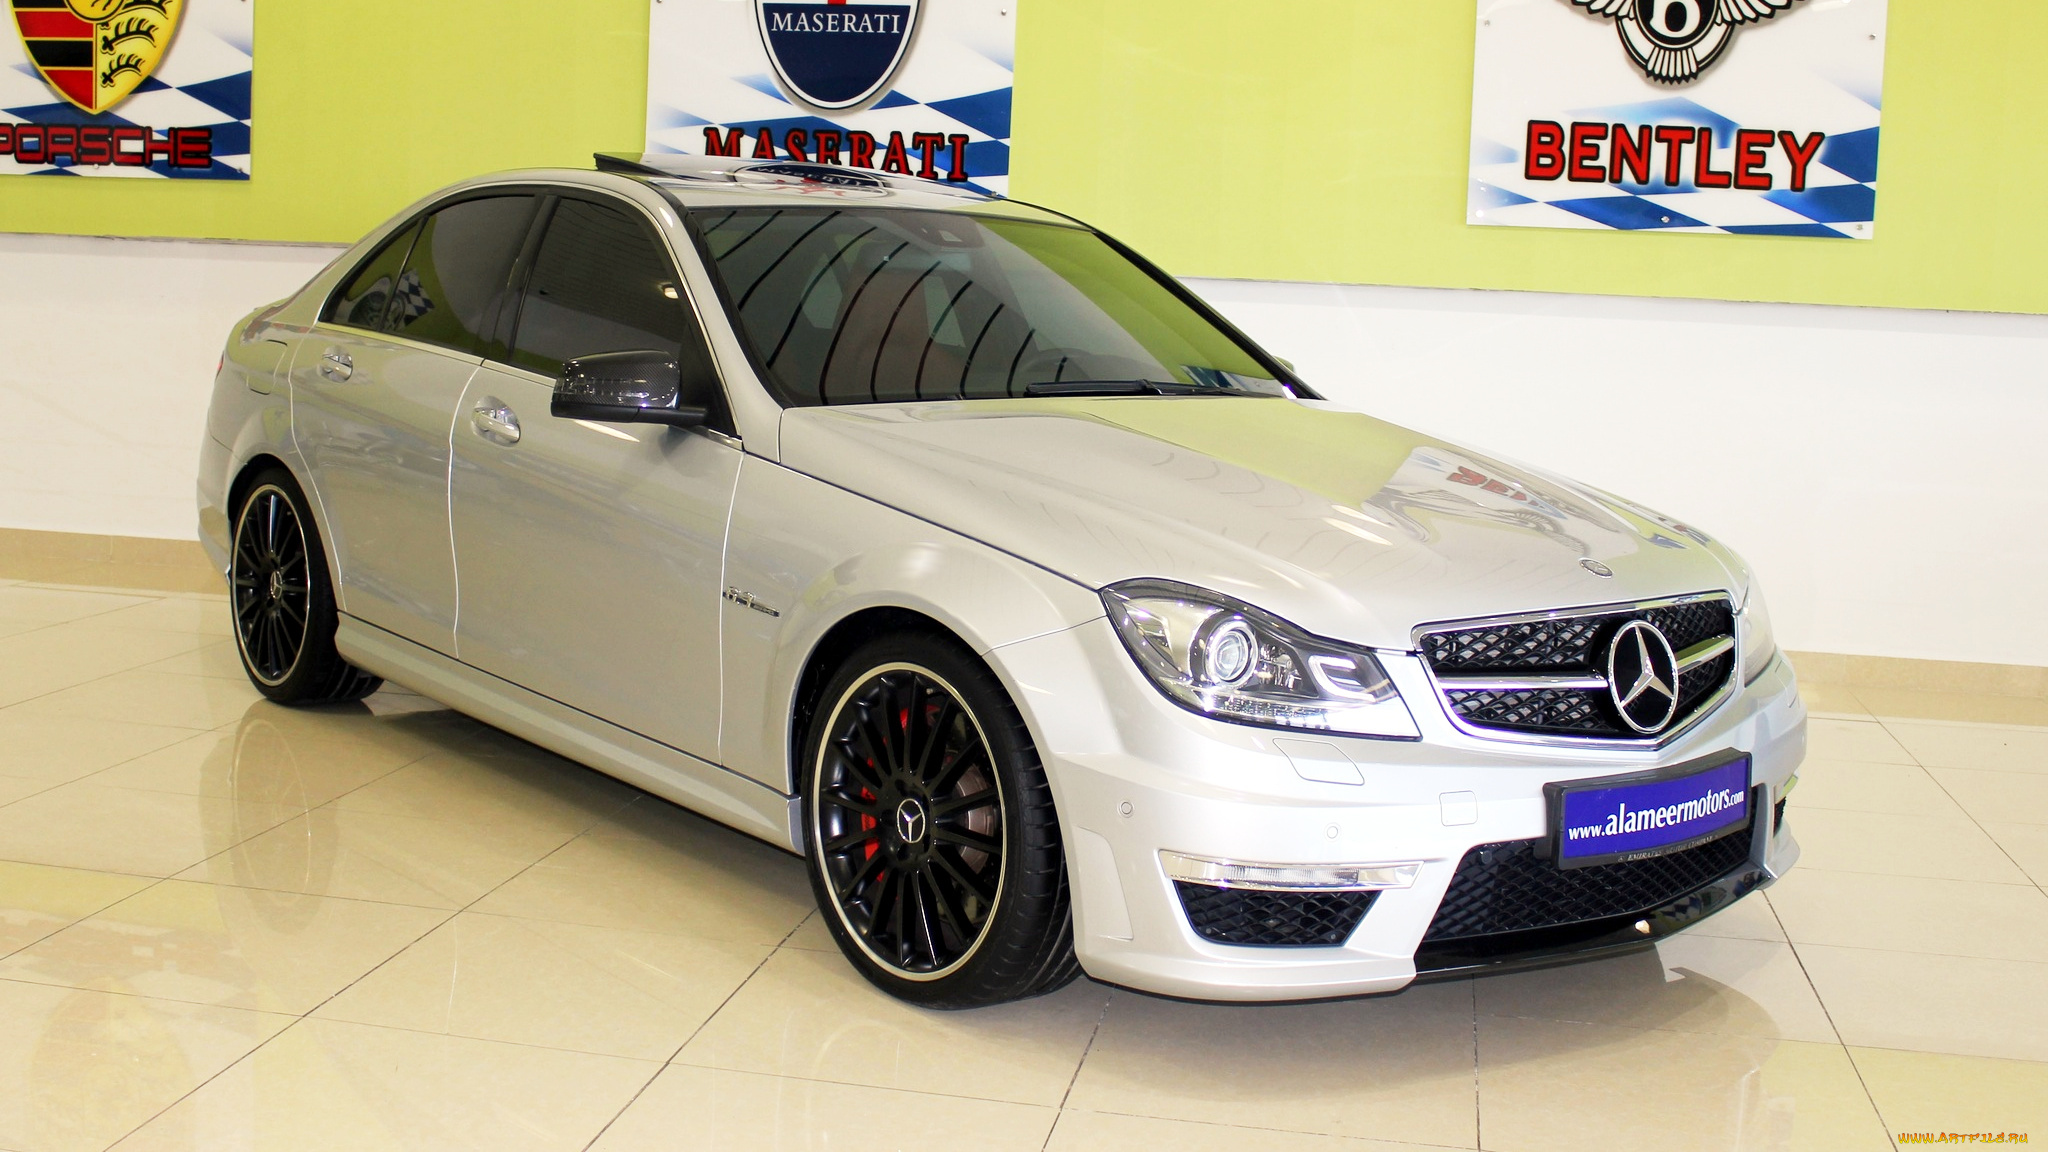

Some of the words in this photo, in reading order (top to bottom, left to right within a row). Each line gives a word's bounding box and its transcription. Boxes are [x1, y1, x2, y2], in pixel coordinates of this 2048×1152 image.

[771, 12, 901, 34] MASERATI
[703, 127, 969, 182] MASERATI
[1524, 120, 1826, 192] BENTLEY
[1567, 788, 1744, 840] www.alameermotors.com
